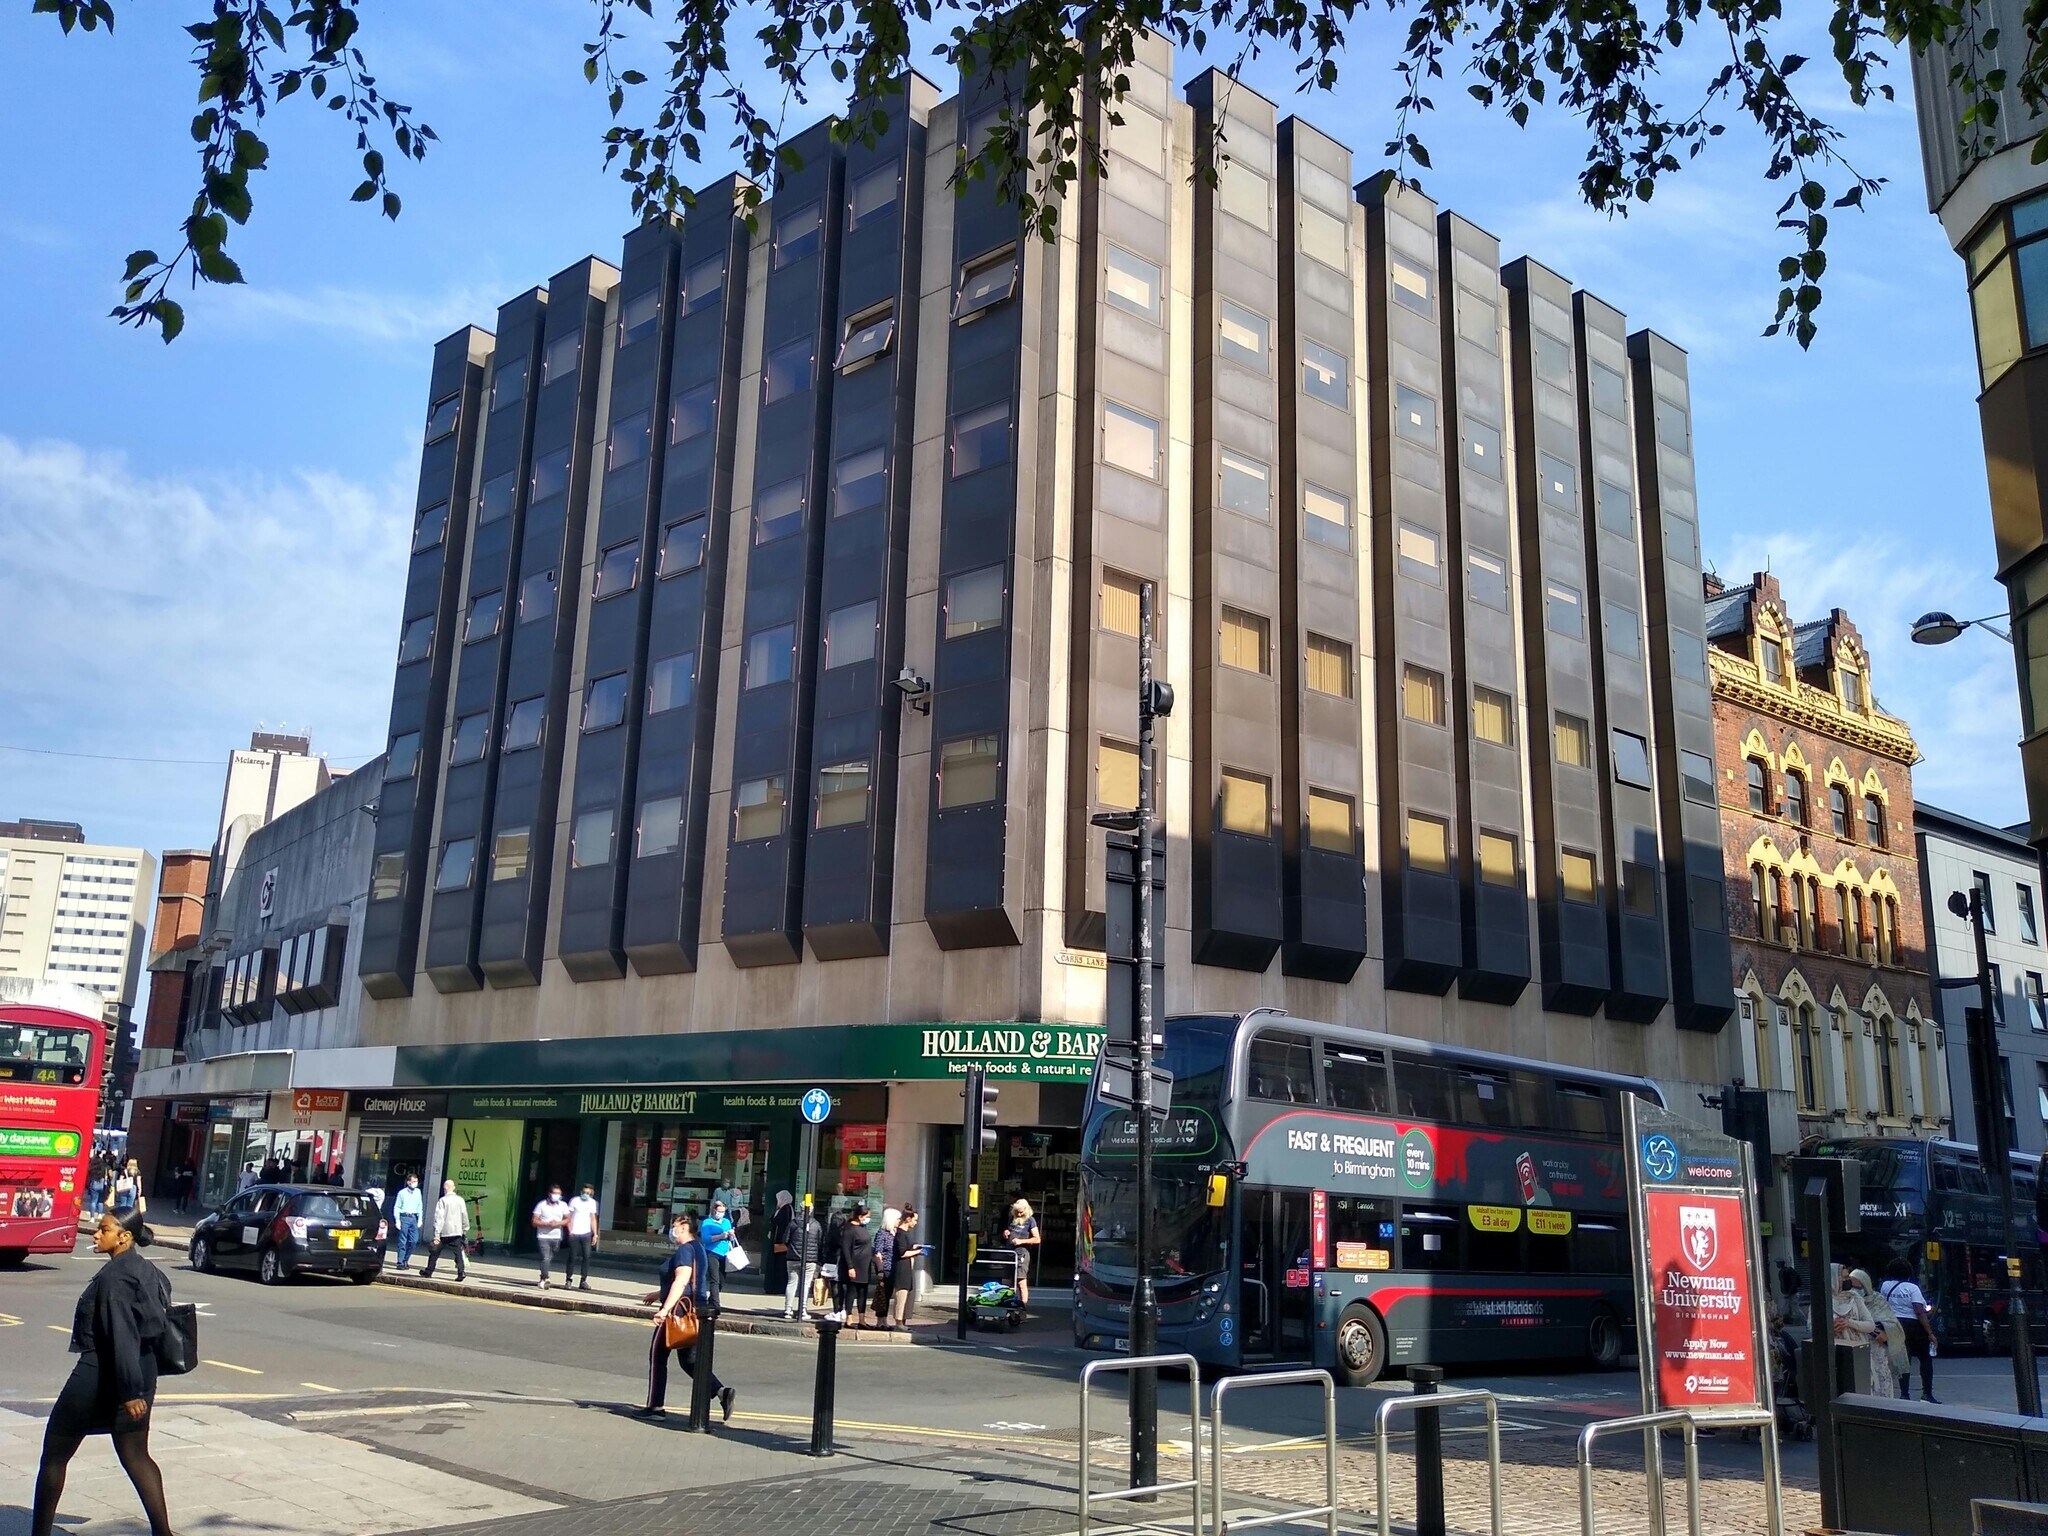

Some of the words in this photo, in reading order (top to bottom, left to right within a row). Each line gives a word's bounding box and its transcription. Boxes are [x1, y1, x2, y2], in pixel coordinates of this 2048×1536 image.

[1060, 955, 1083, 964] CARRS
[1086, 958, 1105, 967] LANE
[921, 1030, 1025, 1057] HOLLAND
[1029, 1030, 1052, 1059] &
[985, 1061, 1017, 1074] foods
[1021, 1062, 1031, 1074] &
[1035, 1062, 1076, 1075] natural
[36, 1069, 57, 1081] 4A
[4, 1095, 24, 1105] West
[24, 1096, 57, 1106] Midlands
[364, 1097, 398, 1115] Gateway
[399, 1098, 427, 1112] House
[473, 1098, 489, 1106] health
[490, 1098, 505, 1107] foods
[506, 1098, 511, 1106] &
[512, 1098, 531, 1106] natural
[532, 1098, 558, 1107] remedies
[579, 1094, 629, 1113] HOLLAND
[631, 1094, 642, 1114] &
[644, 1091, 697, 1114] BARRETT
[723, 1096, 745, 1106] health
[746, 1096, 767, 1106] foods
[769, 1096, 776, 1106] &
[9, 1132, 51, 1145] daysaver
[1288, 1130, 1318, 1151] FAST
[1320, 1133, 1331, 1152] &
[1333, 1134, 1395, 1158] FREQUENT
[1406, 1149, 1425, 1160] every
[460, 1158, 478, 1168] CLICK
[480, 1159, 485, 1168] &
[1406, 1158, 1414, 1169] 10
[1415, 1160, 1430, 1171] mins
[1559, 1161, 1570, 1171] play
[458, 1171, 487, 1181] COLLECT
[1333, 1160, 1343, 1174] to
[1344, 1160, 1395, 1180] Birmingham
[1688, 1166, 1732, 1178] welcome
[1893, 1202, 1907, 1217] X1
[1482, 1215, 1491, 1226] £3
[1492, 1218, 1500, 1227] all
[1500, 1218, 1510, 1229] day
[1535, 1218, 1546, 1229] £11
[1552, 1222, 1565, 1230] week
[1942, 1210, 1955, 1228] X2
[1667, 1271, 1736, 1291] Newman
[1662, 1289, 1742, 1314] University
[1676, 1312, 1729, 1320] BIRMINGHAM
[1683, 1338, 1708, 1350] Apply
[1709, 1338, 1728, 1349] Now
[1665, 1350, 1745, 1360] www.newman.ac.uk
